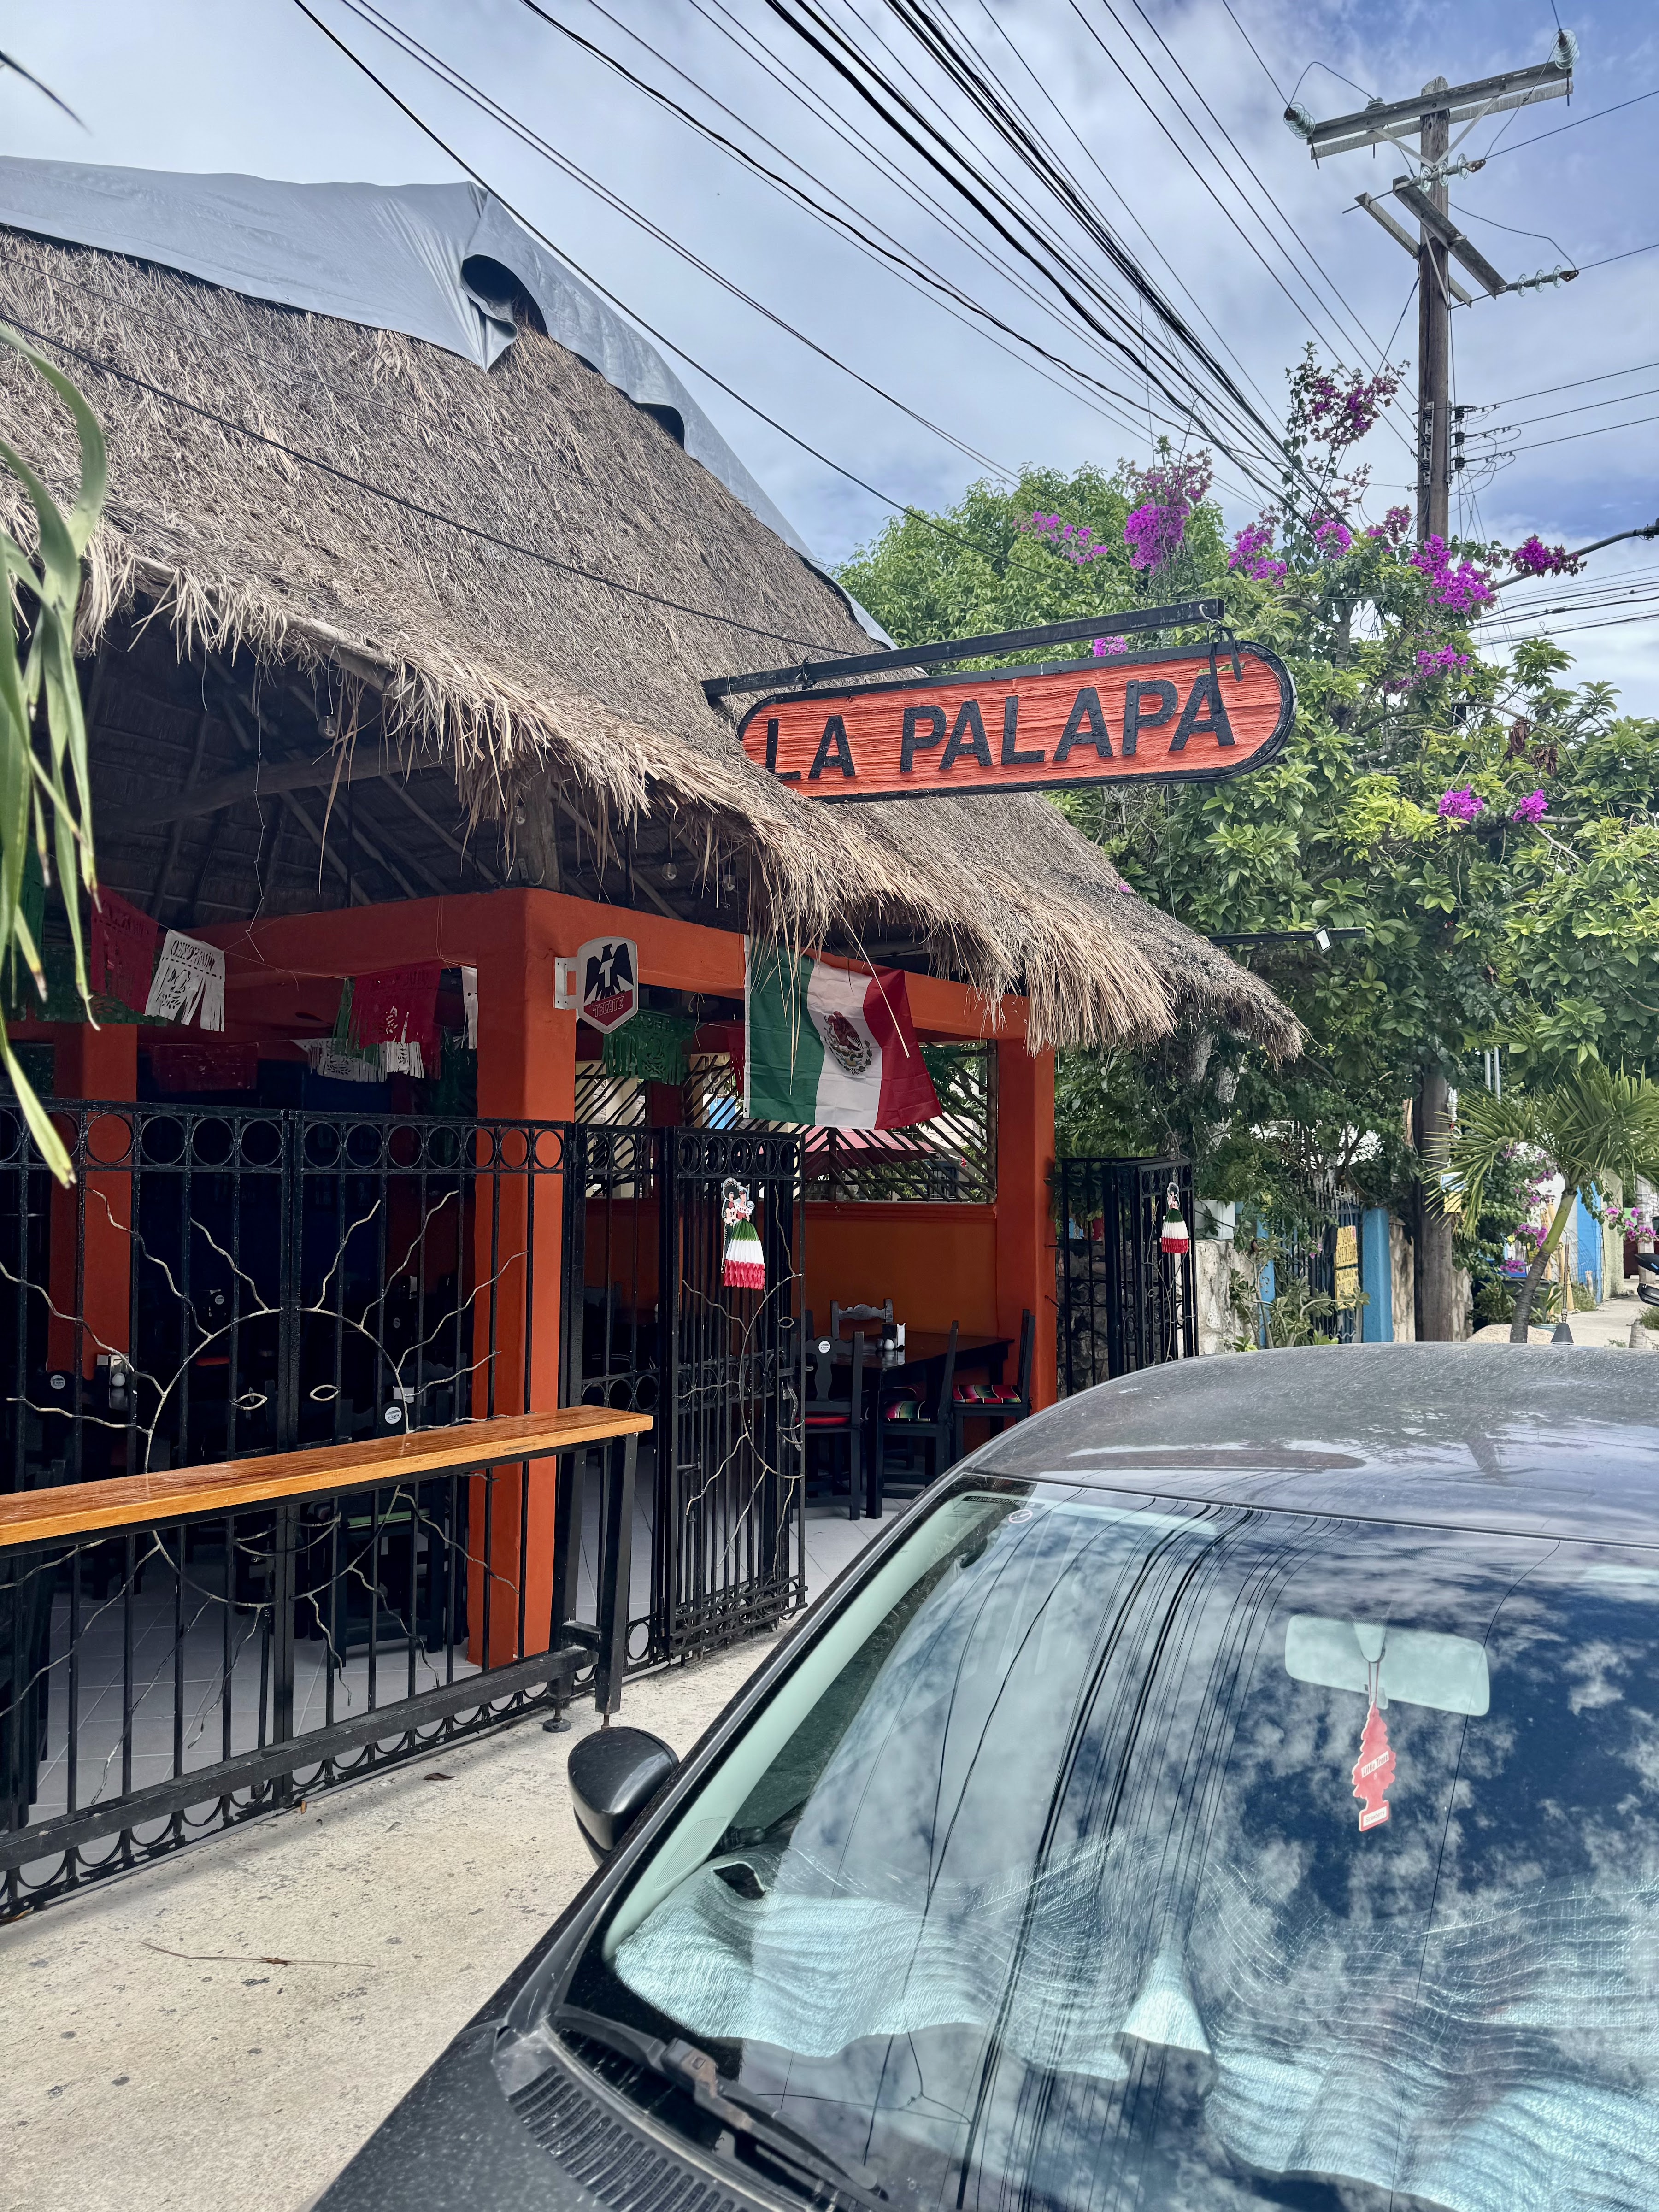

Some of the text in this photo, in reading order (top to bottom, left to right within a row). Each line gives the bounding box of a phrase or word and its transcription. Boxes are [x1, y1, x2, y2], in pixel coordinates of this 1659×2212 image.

[765, 673, 1236, 781] LA PALAPA
[592, 995, 624, 1018] TECATE
[1363, 1754, 1388, 1776] Little Trees
